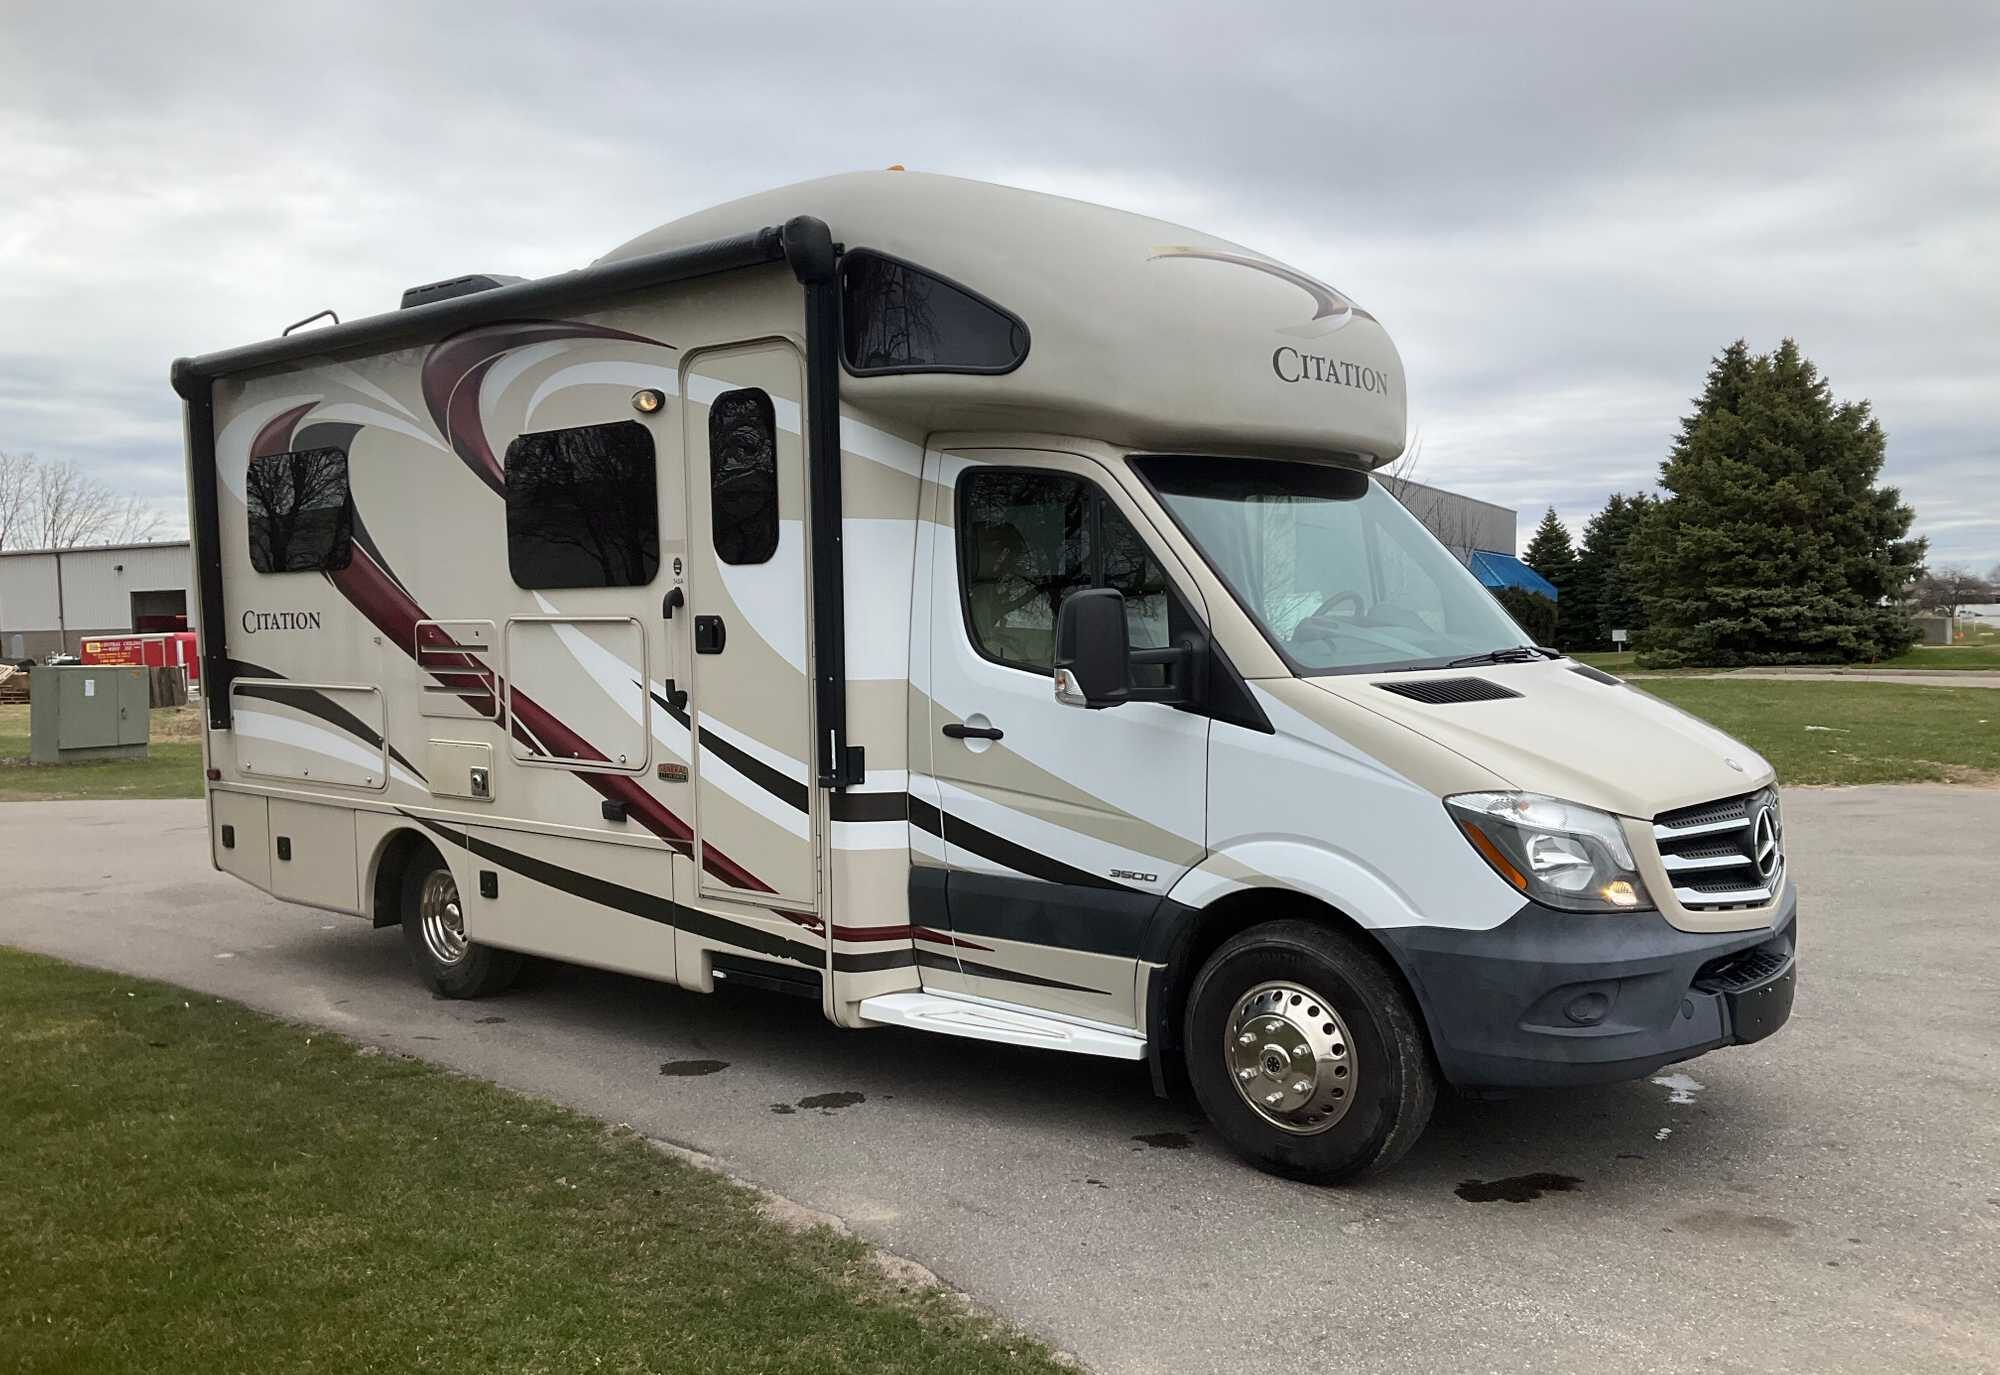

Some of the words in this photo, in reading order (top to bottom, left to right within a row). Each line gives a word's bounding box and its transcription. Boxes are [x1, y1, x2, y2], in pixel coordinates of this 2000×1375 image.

[1272, 346, 1388, 395] CITATION
[242, 609, 321, 634] CITATION
[1109, 869, 1158, 882] 3500
